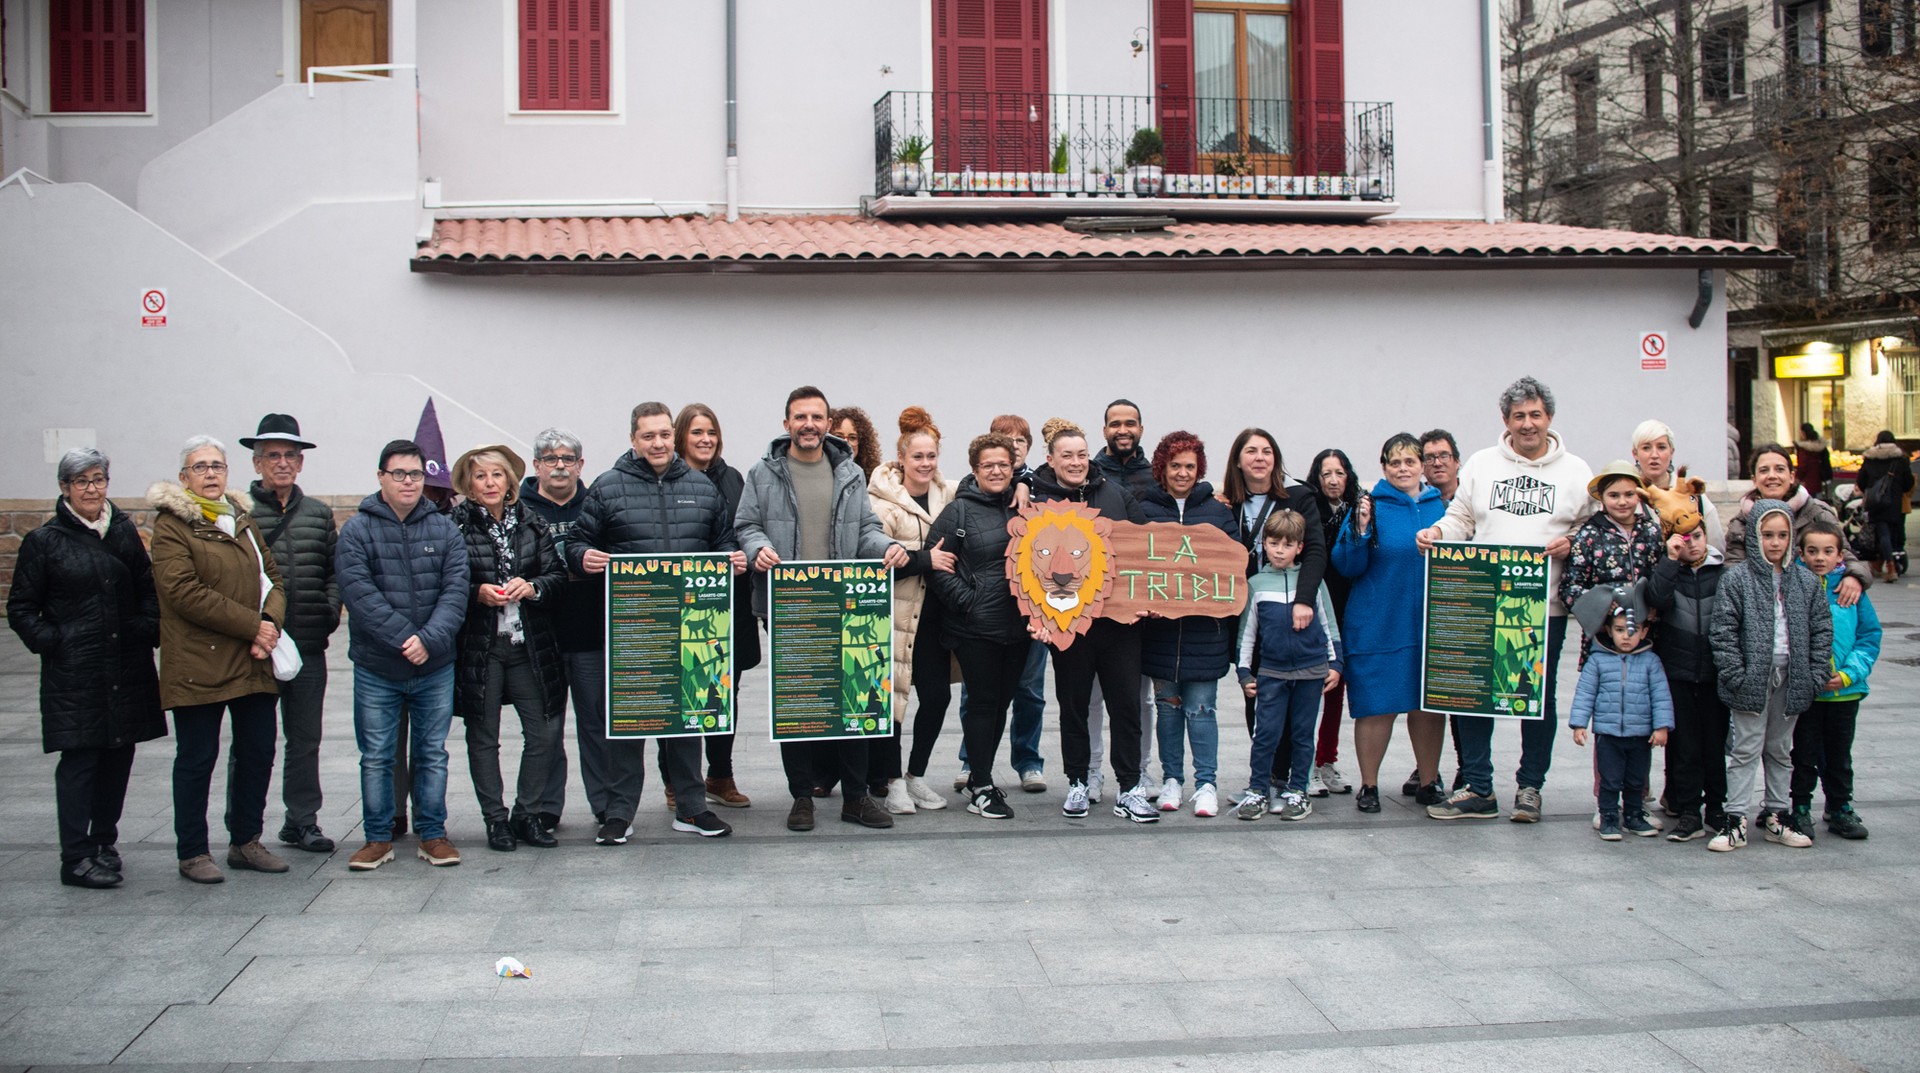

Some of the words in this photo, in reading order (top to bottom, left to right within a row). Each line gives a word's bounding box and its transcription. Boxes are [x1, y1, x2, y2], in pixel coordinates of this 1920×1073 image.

[1147, 532, 1198, 564] LA
[1431, 546, 1545, 565] INAUTERIAK
[612, 559, 728, 576] INAUTERIAK
[774, 566, 888, 583] INAUTERIAK
[1501, 564, 1544, 577] 2024
[685, 576, 727, 588] 2024
[845, 582, 888, 594] 2024
[1119, 570, 1236, 603] TRIBU
